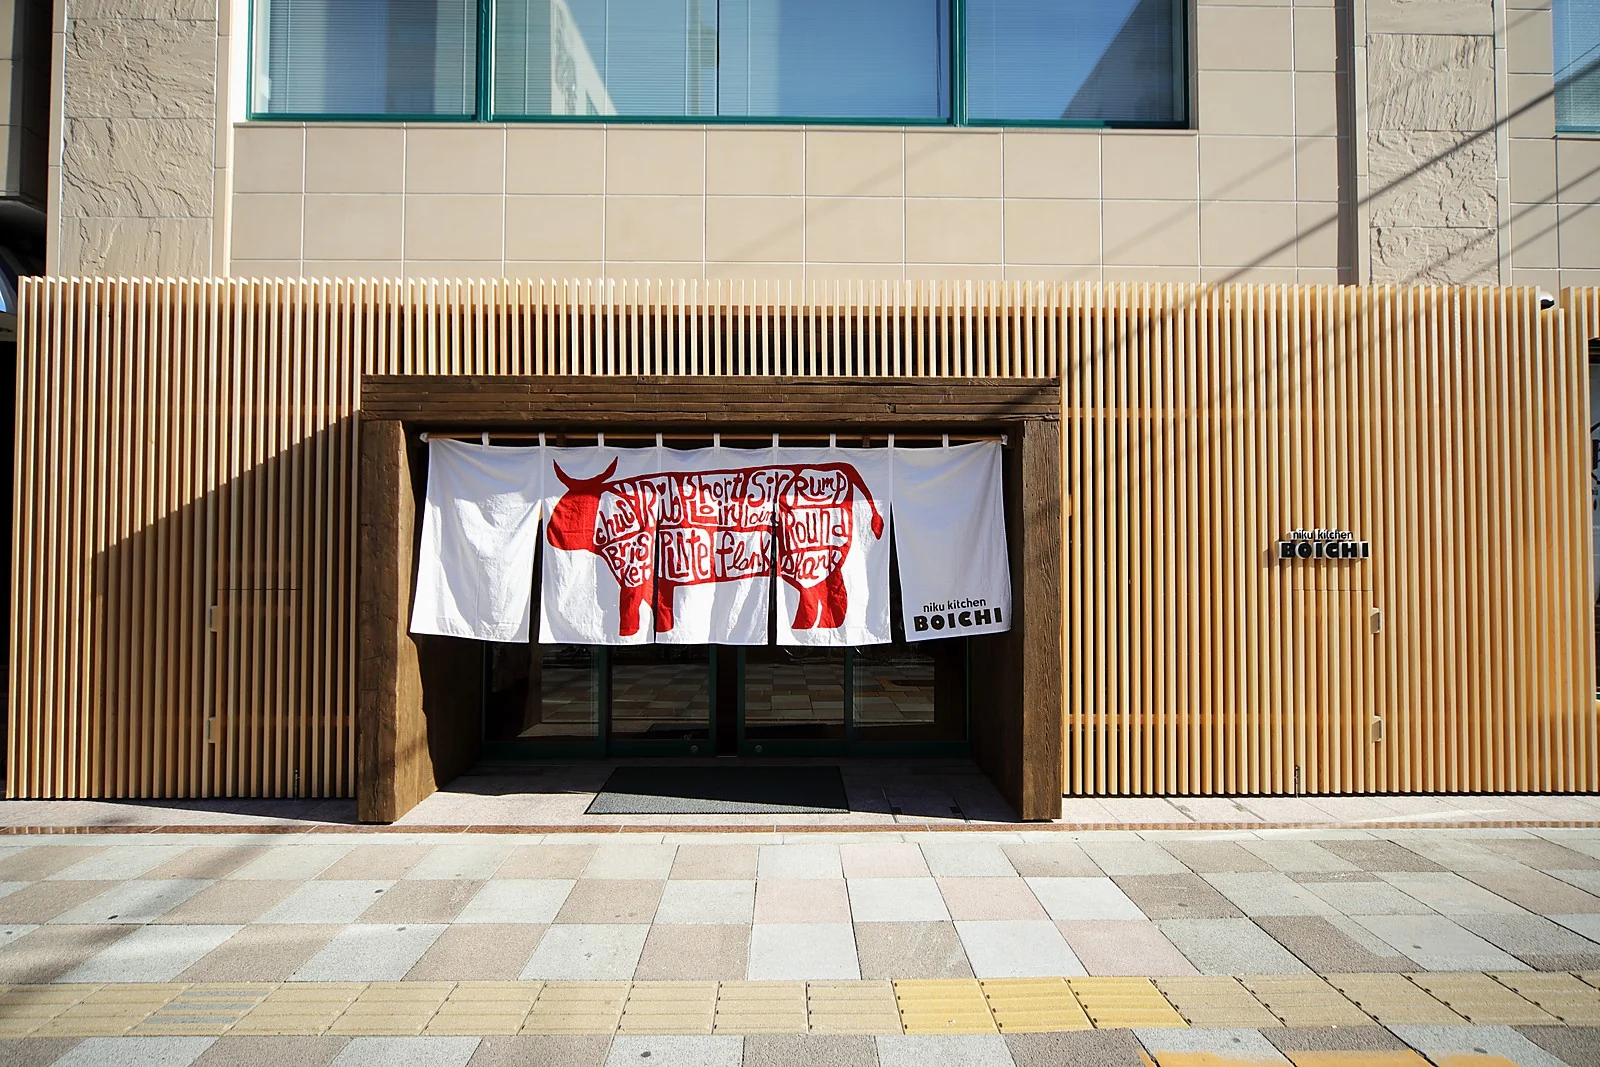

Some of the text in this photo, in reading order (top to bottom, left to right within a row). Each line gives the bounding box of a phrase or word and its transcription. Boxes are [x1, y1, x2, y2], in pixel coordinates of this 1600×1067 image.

[639, 476, 682, 531] Rib
[1292, 529, 1353, 540] niku kitchen
[1280, 542, 1368, 558] BOICHI
[923, 598, 987, 613] niku kitchen
[913, 607, 1003, 632] BOICHI
